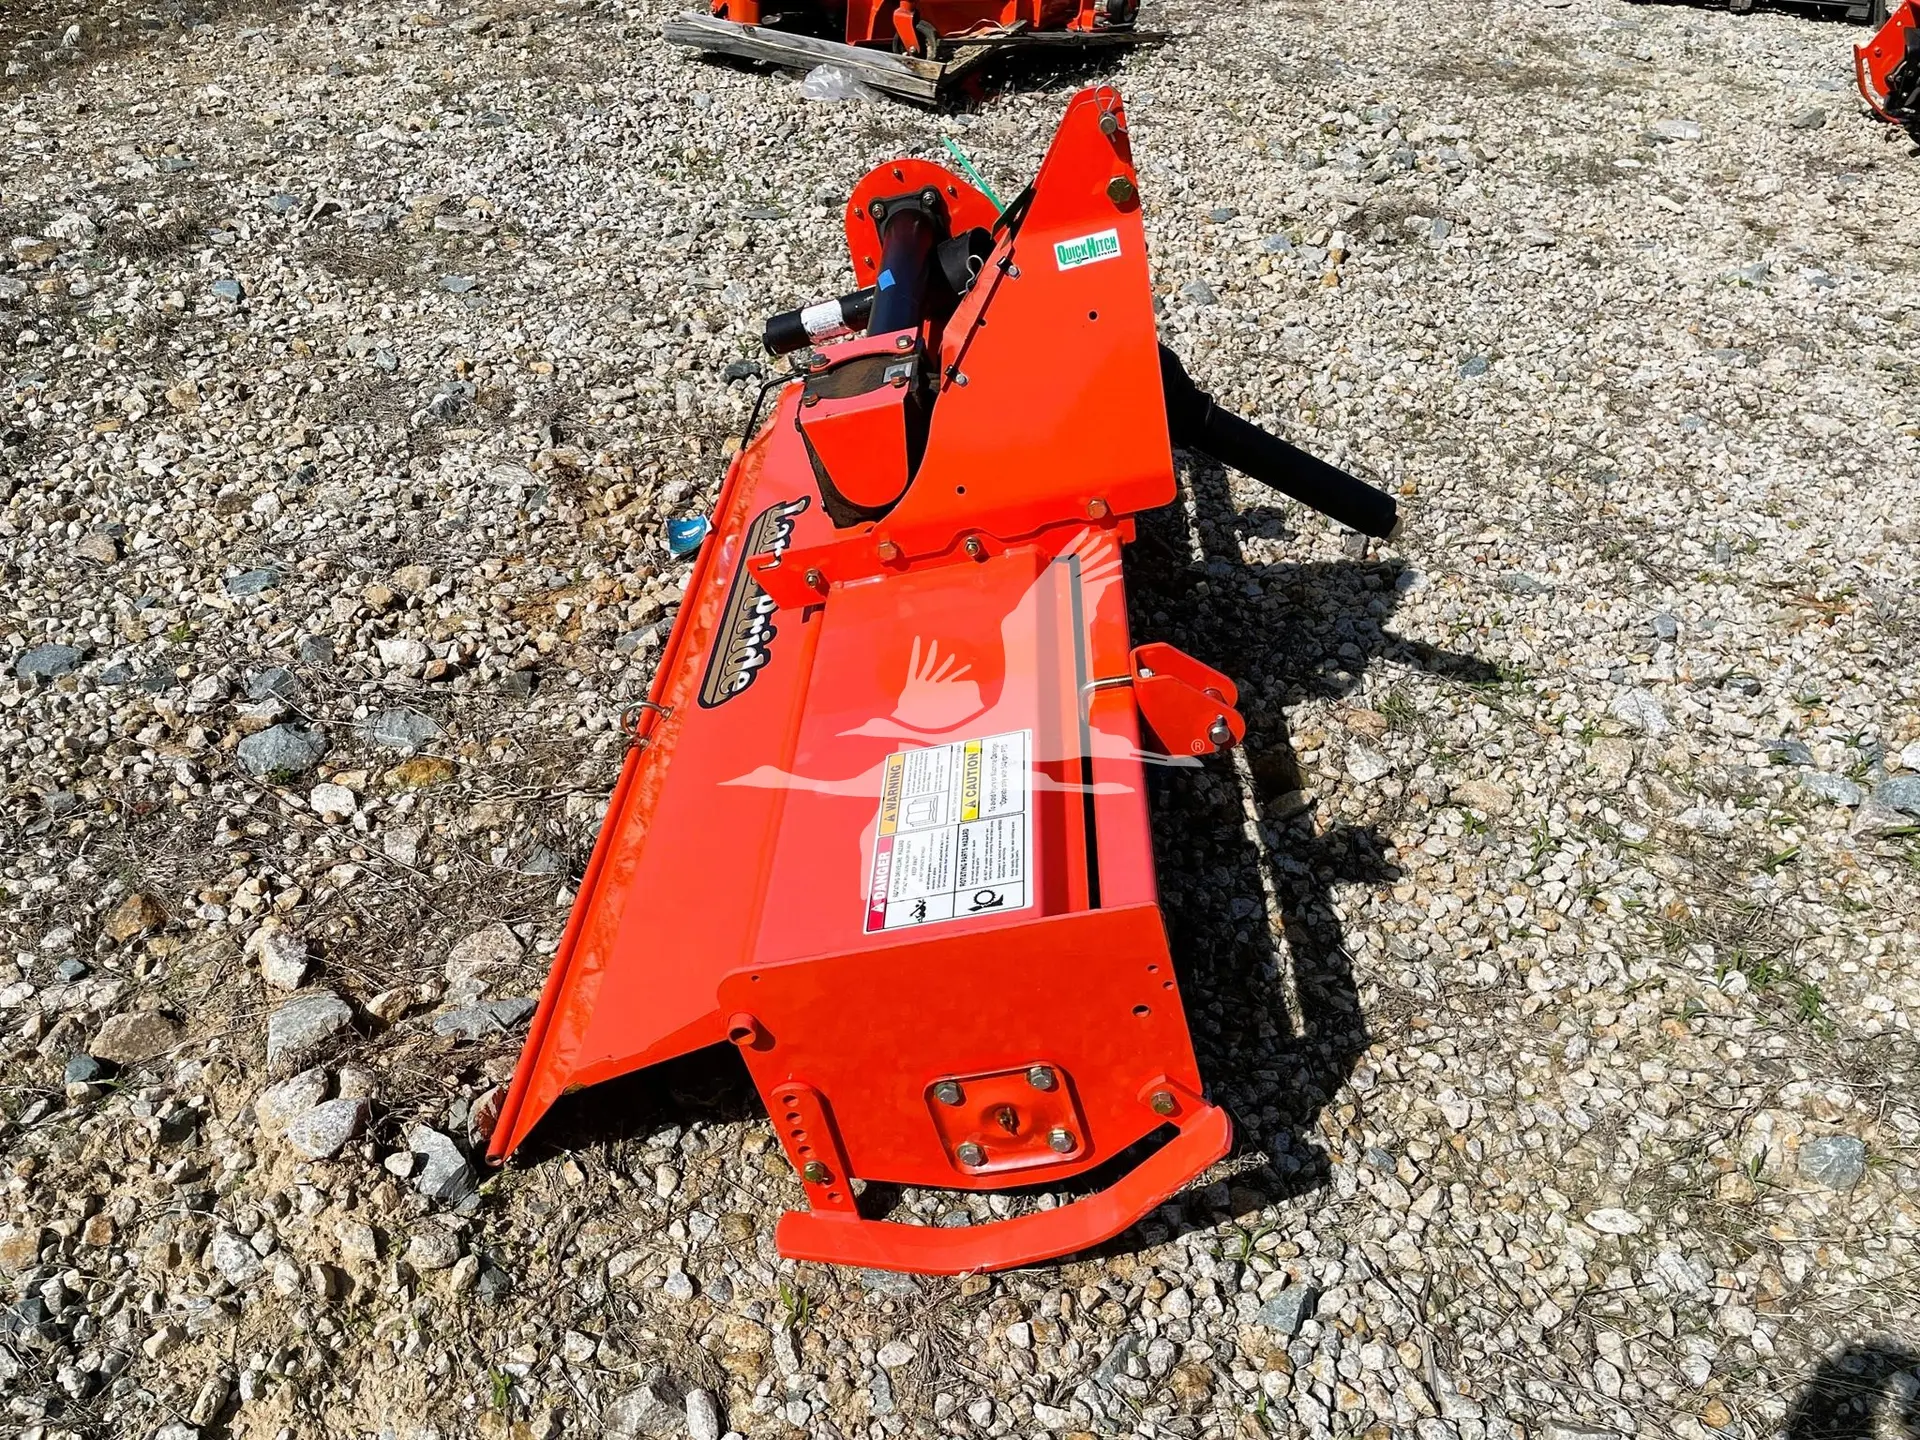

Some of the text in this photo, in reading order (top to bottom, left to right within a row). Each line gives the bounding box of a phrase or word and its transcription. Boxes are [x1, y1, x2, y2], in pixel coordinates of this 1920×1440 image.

[720, 594, 777, 694] Pride
[885, 765, 901, 812] WARNING
[965, 753, 978, 799] CAUTION
[873, 851, 890, 902] DANGER
